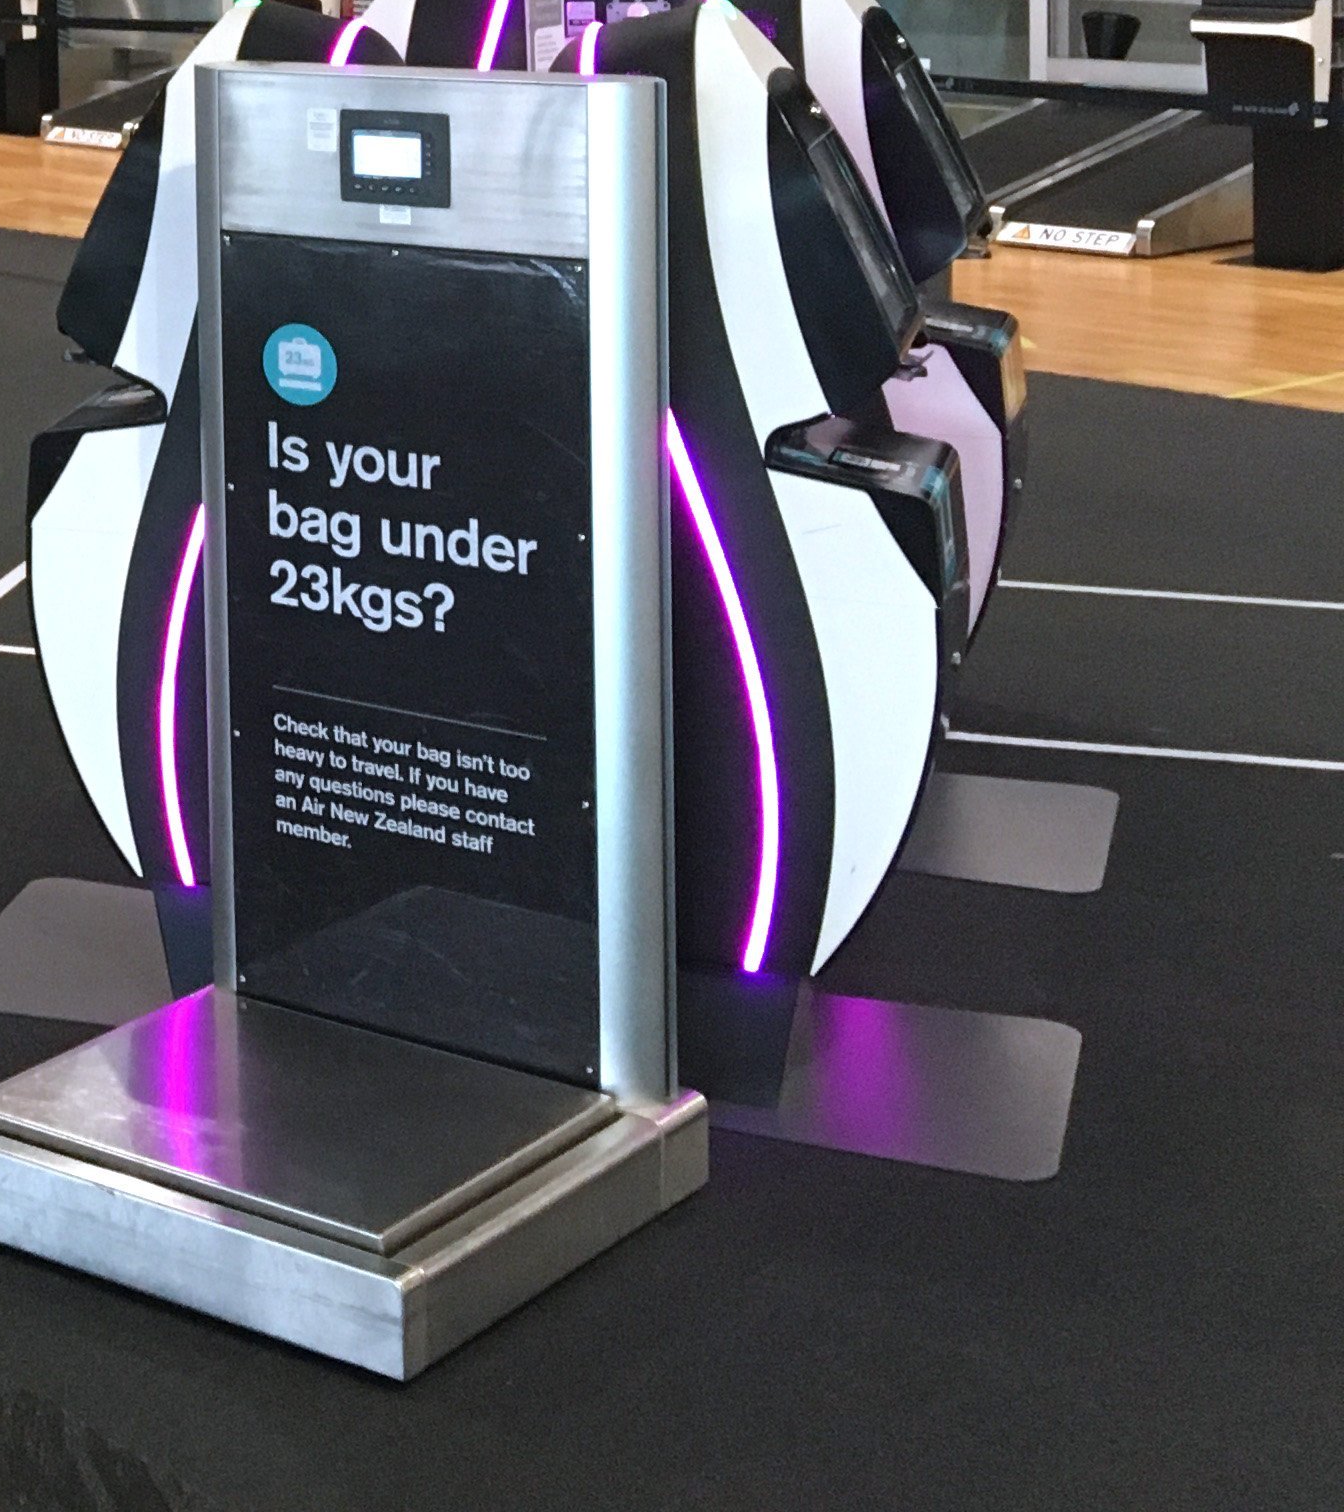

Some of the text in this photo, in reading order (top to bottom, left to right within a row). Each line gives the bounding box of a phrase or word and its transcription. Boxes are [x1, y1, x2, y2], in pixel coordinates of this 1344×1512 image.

[1039, 228, 1119, 246] NO STEP
[268, 421, 441, 490] Is your
[268, 489, 538, 575] bag under
[269, 559, 455, 633] 23kgs?
[273, 713, 530, 781] Check that your bag isn't too
[274, 739, 509, 804] heavy to travel. If you have
[275, 766, 535, 836] any questions please contact
[275, 793, 494, 854] an Air New Zealand staff
[276, 819, 353, 849] member.
